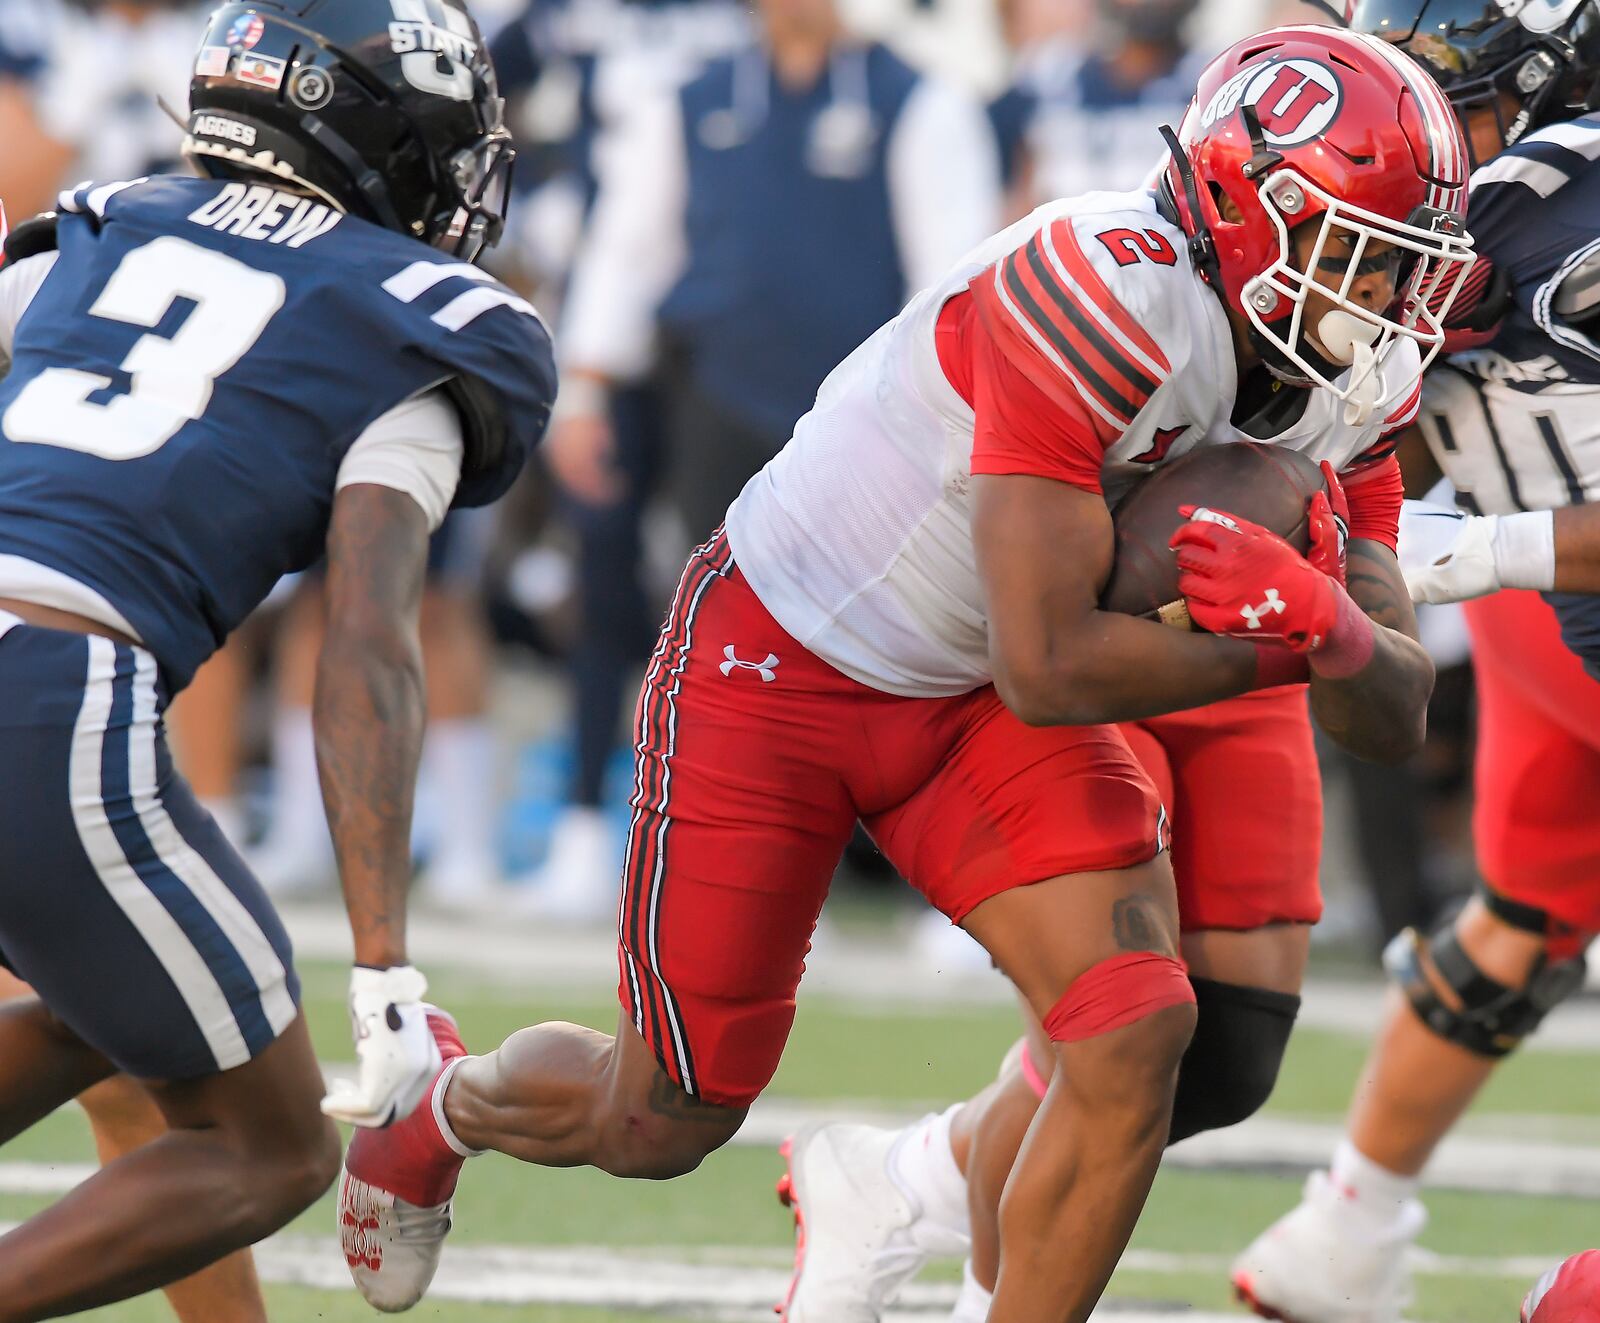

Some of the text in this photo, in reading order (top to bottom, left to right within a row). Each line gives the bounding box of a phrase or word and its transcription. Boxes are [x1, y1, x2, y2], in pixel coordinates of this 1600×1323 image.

[388, 21, 478, 67] STATE
[1253, 64, 1335, 137] U
[193, 115, 258, 147] AGGIES
[187, 182, 344, 249] DREW
[1094, 227, 1178, 268] 2
[1, 235, 287, 461] 3
